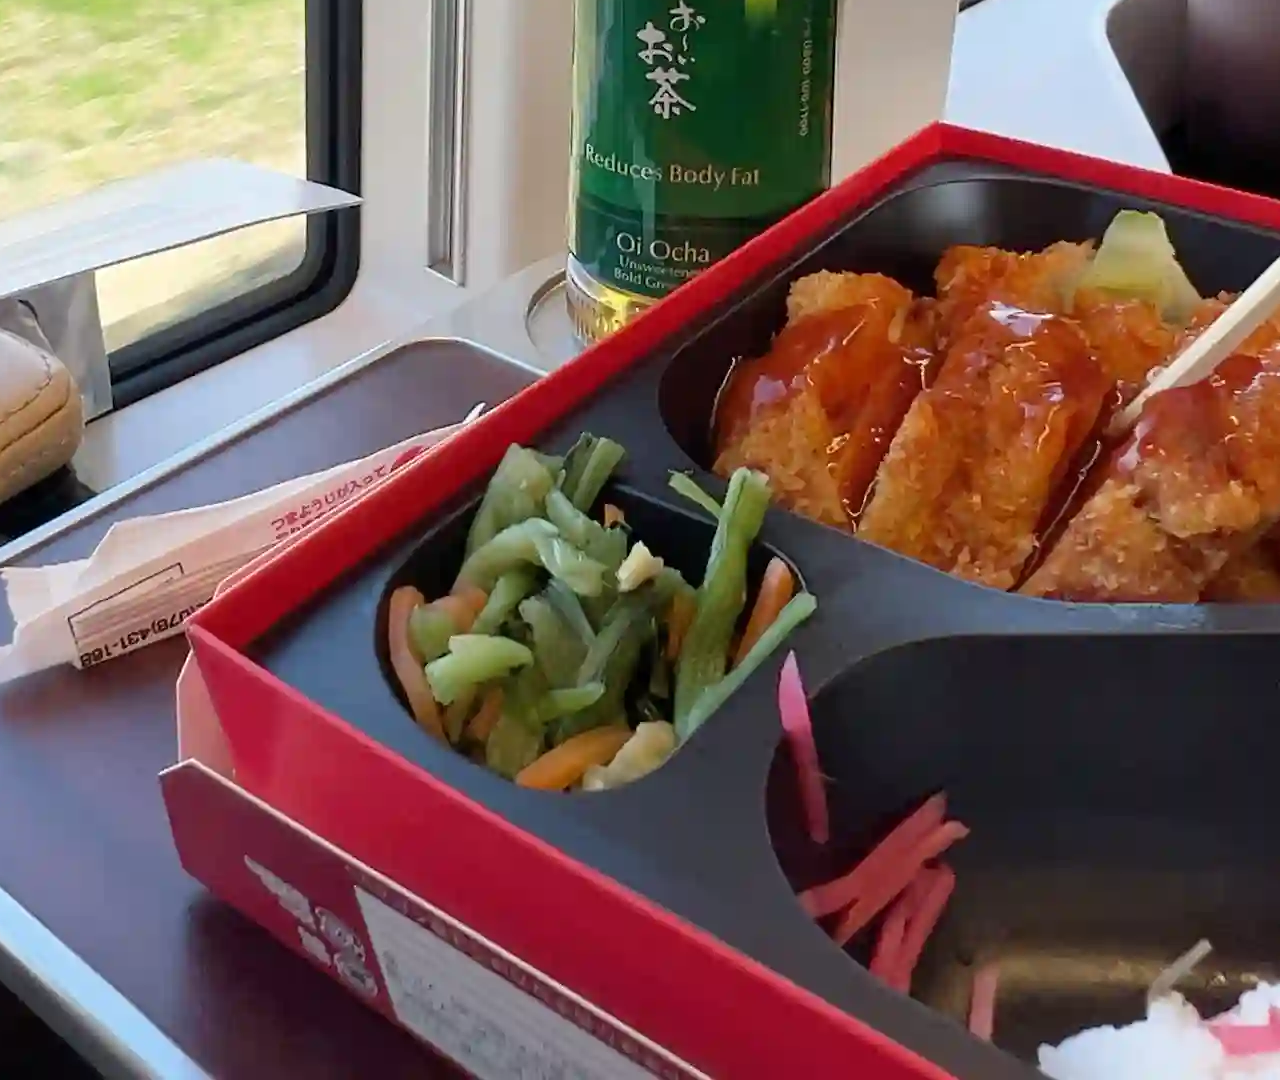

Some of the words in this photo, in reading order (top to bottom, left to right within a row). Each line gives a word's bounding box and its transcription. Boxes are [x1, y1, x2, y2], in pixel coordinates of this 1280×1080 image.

[585, 143, 663, 182] Reduces
[669, 163, 726, 192] Body
[731, 167, 760, 186] Fat
[616, 231, 642, 255] Oi
[649, 240, 710, 264] Ocha
[613, 266, 642, 286] Bold
